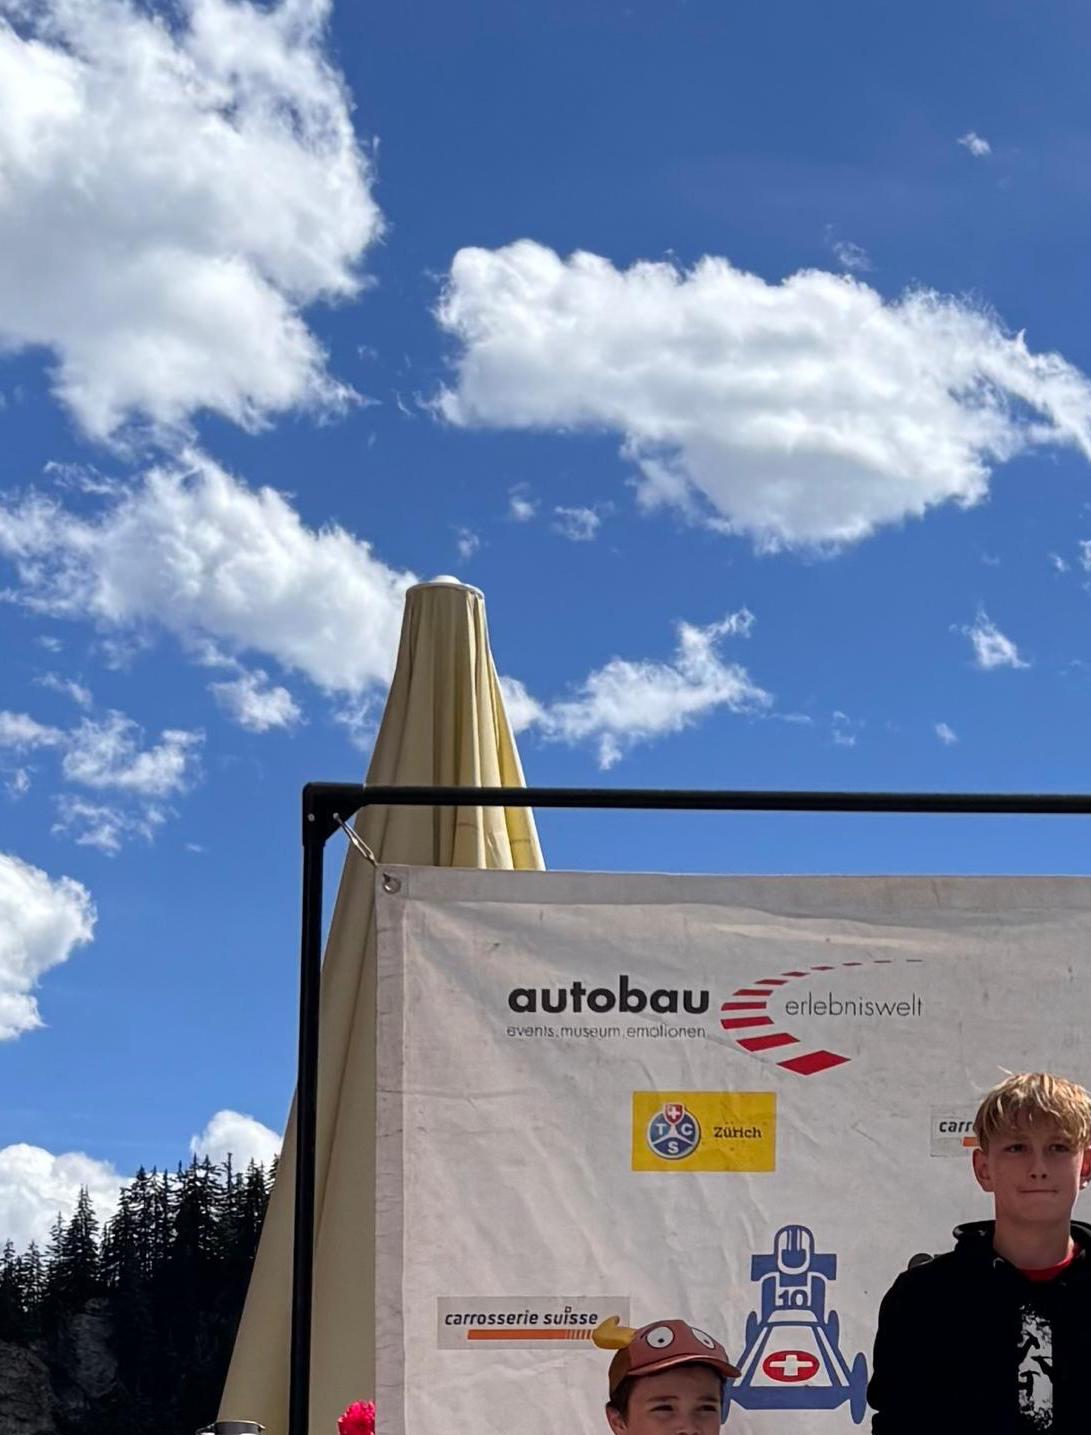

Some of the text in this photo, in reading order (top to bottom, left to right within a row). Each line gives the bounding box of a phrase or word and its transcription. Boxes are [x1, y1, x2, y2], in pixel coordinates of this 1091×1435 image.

[508, 974, 923, 1018] autobau erlebniswelt
[713, 1126, 762, 1139] Zürich
[939, 1121, 976, 1133] carr
[778, 1288, 809, 1308] 10
[445, 1305, 598, 1326] carrosserie suisse
